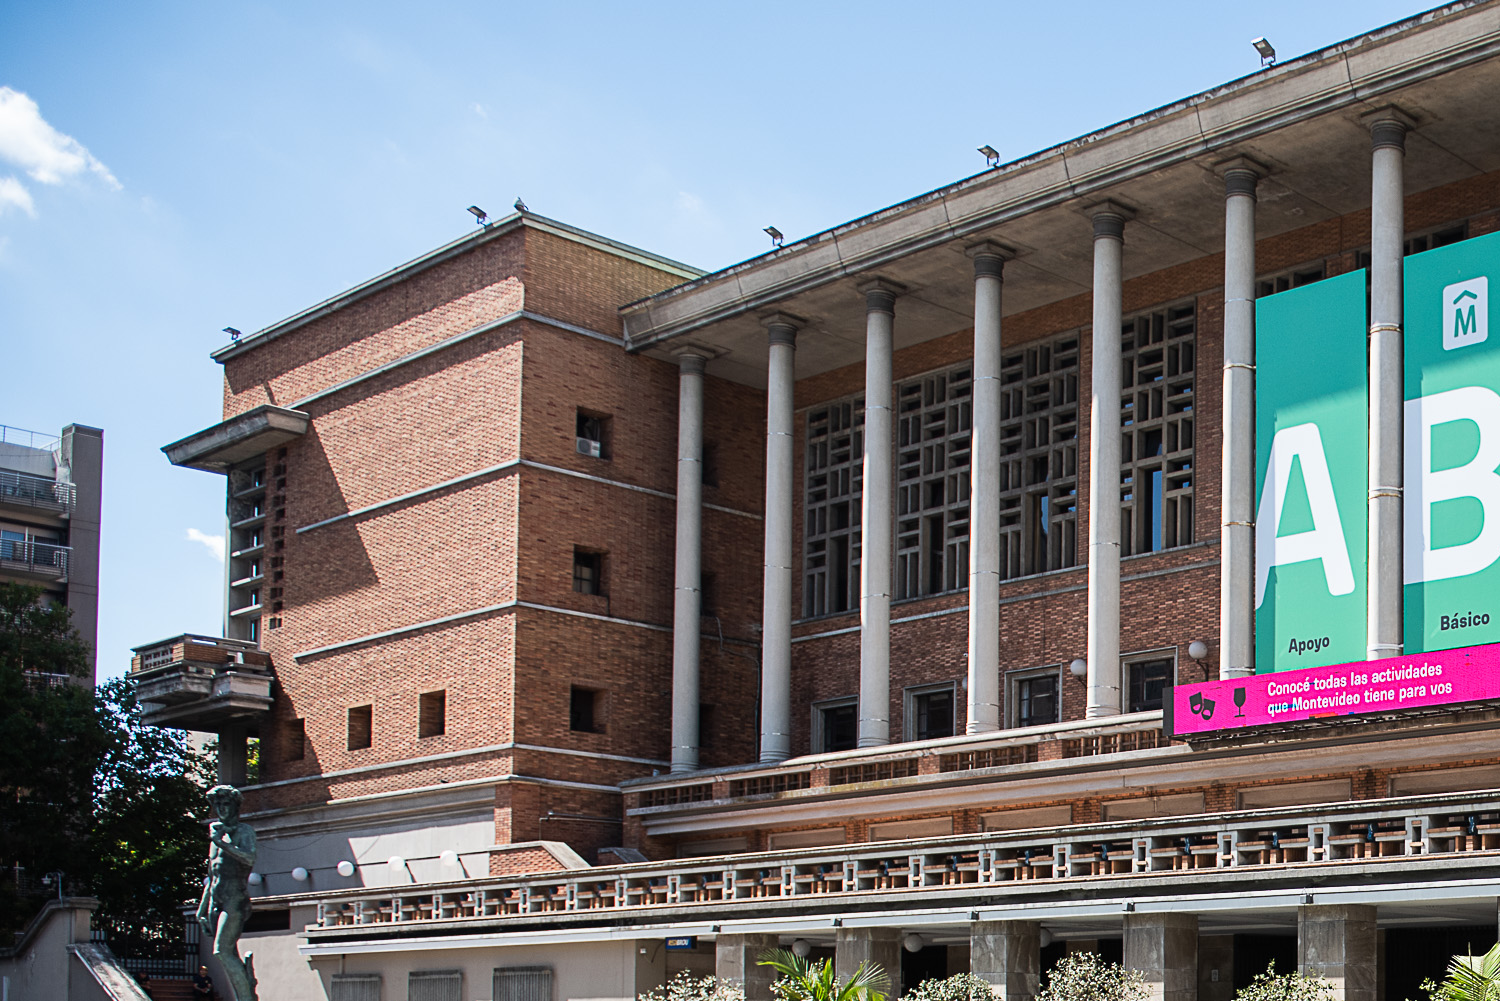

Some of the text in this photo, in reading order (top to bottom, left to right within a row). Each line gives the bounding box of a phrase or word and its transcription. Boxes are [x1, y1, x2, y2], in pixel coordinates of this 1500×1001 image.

[1256, 422, 1356, 610] A
[1440, 612, 1490, 630] Básico
[1289, 636, 1330, 655] Apoyo
[1268, 663, 1442, 696] Conocé todas las actividades
[1268, 682, 1452, 717] que Montevideo tiene para vos
